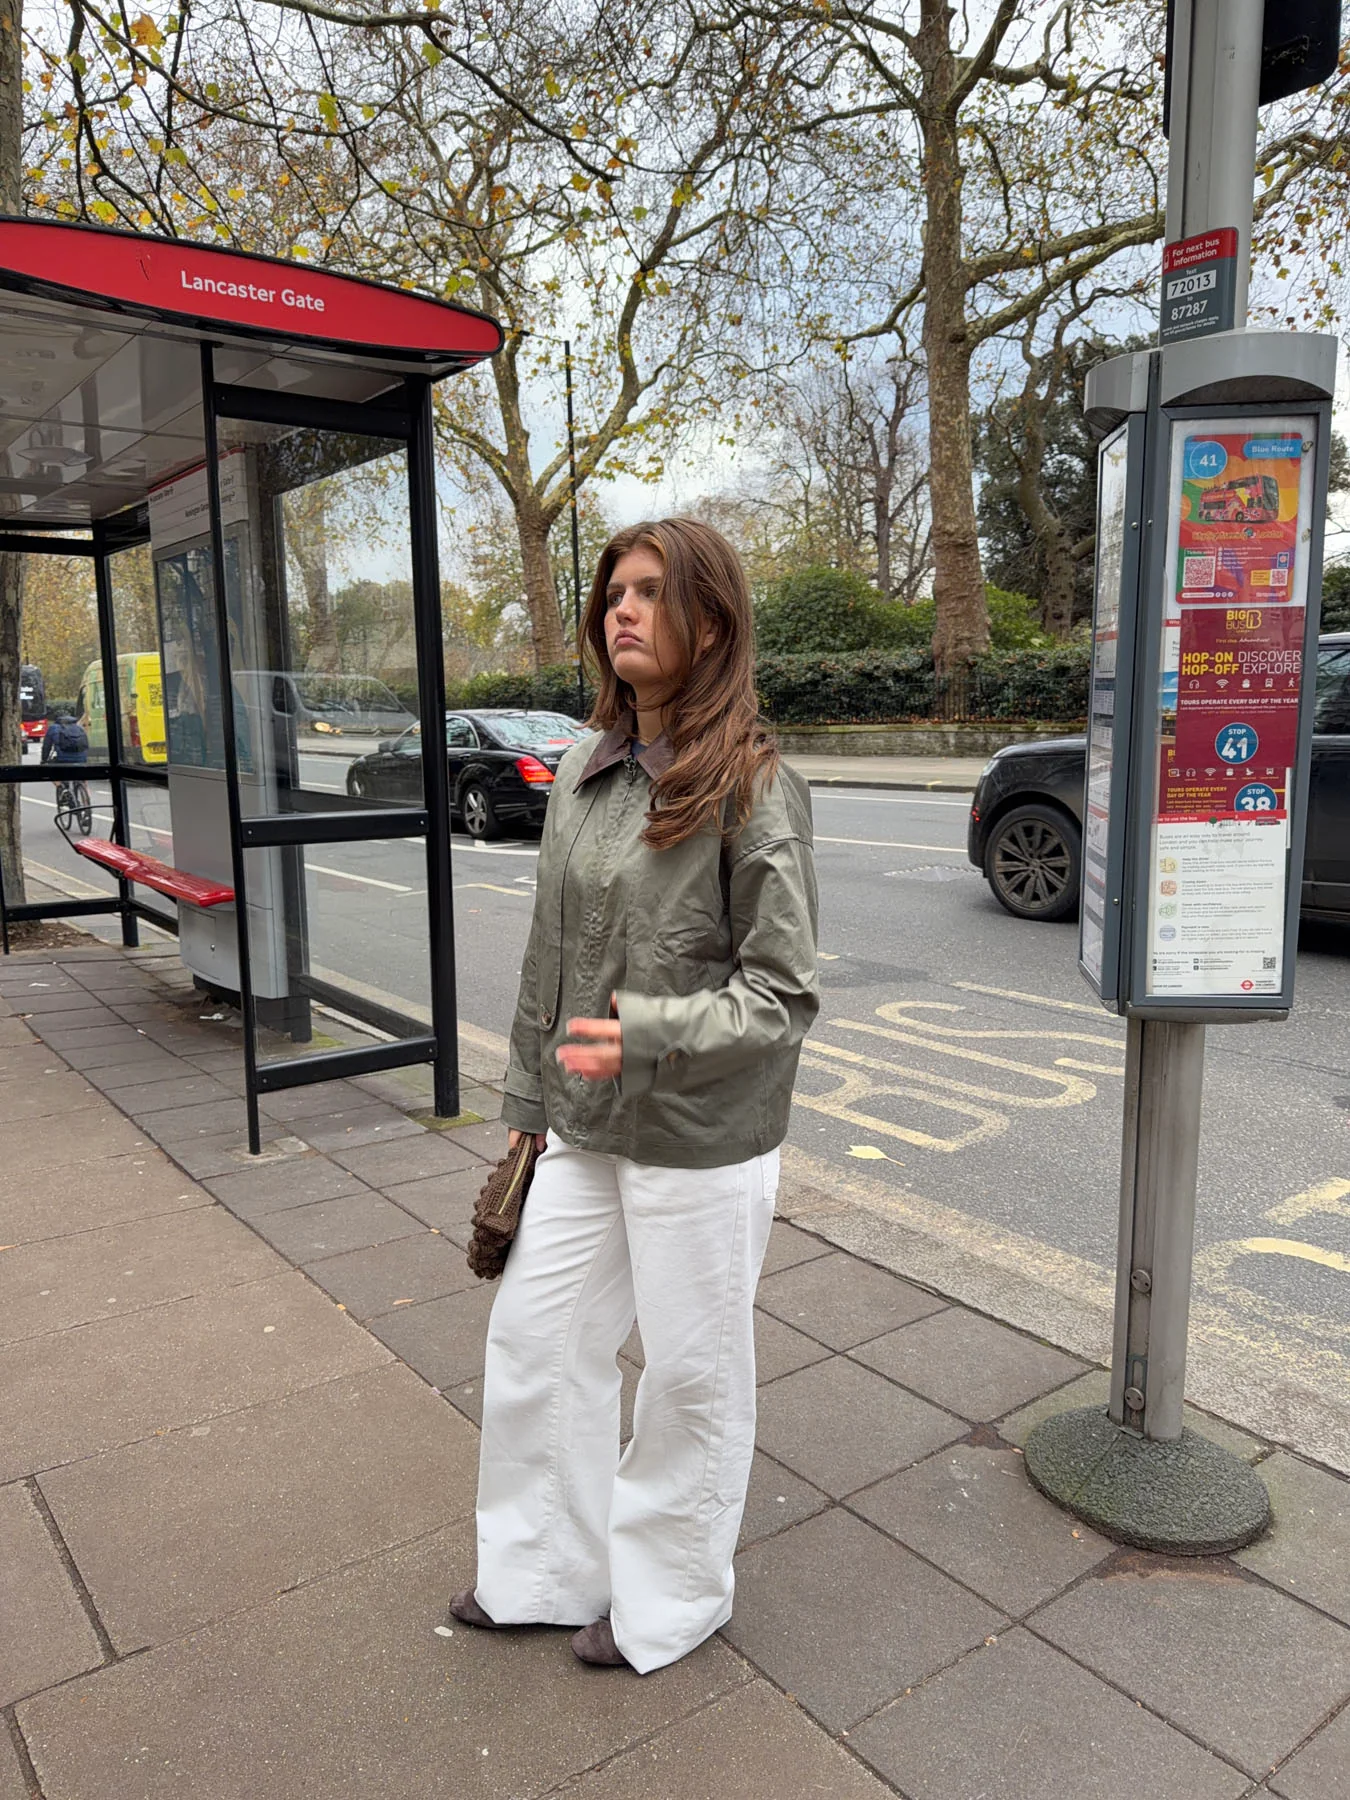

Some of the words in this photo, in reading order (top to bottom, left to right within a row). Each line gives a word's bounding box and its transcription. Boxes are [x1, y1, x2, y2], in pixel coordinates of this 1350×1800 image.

[1172, 248, 1184, 258] For
[1186, 243, 1203, 255] next
[1205, 238, 1220, 249] bus
[1173, 249, 1217, 266] information
[181, 270, 276, 303] Lancaster
[280, 288, 326, 312] Gate
[1171, 273, 1212, 297] 72013
[1170, 299, 1209, 321] 87287
[1252, 445, 1270, 454] Blue
[1272, 445, 1294, 453] Route
[1200, 454, 1218, 467] 41
[1226, 610, 1247, 621] BIG
[1226, 620, 1245, 630] BUS
[1182, 651, 1234, 664] HOP-ON
[1238, 650, 1301, 663] DISCOVER
[1181, 663, 1240, 676] HOP-OFF
[1242, 662, 1301, 675] EXPLORE
[1222, 738, 1248, 760] 41
[1240, 796, 1271, 812] 38
